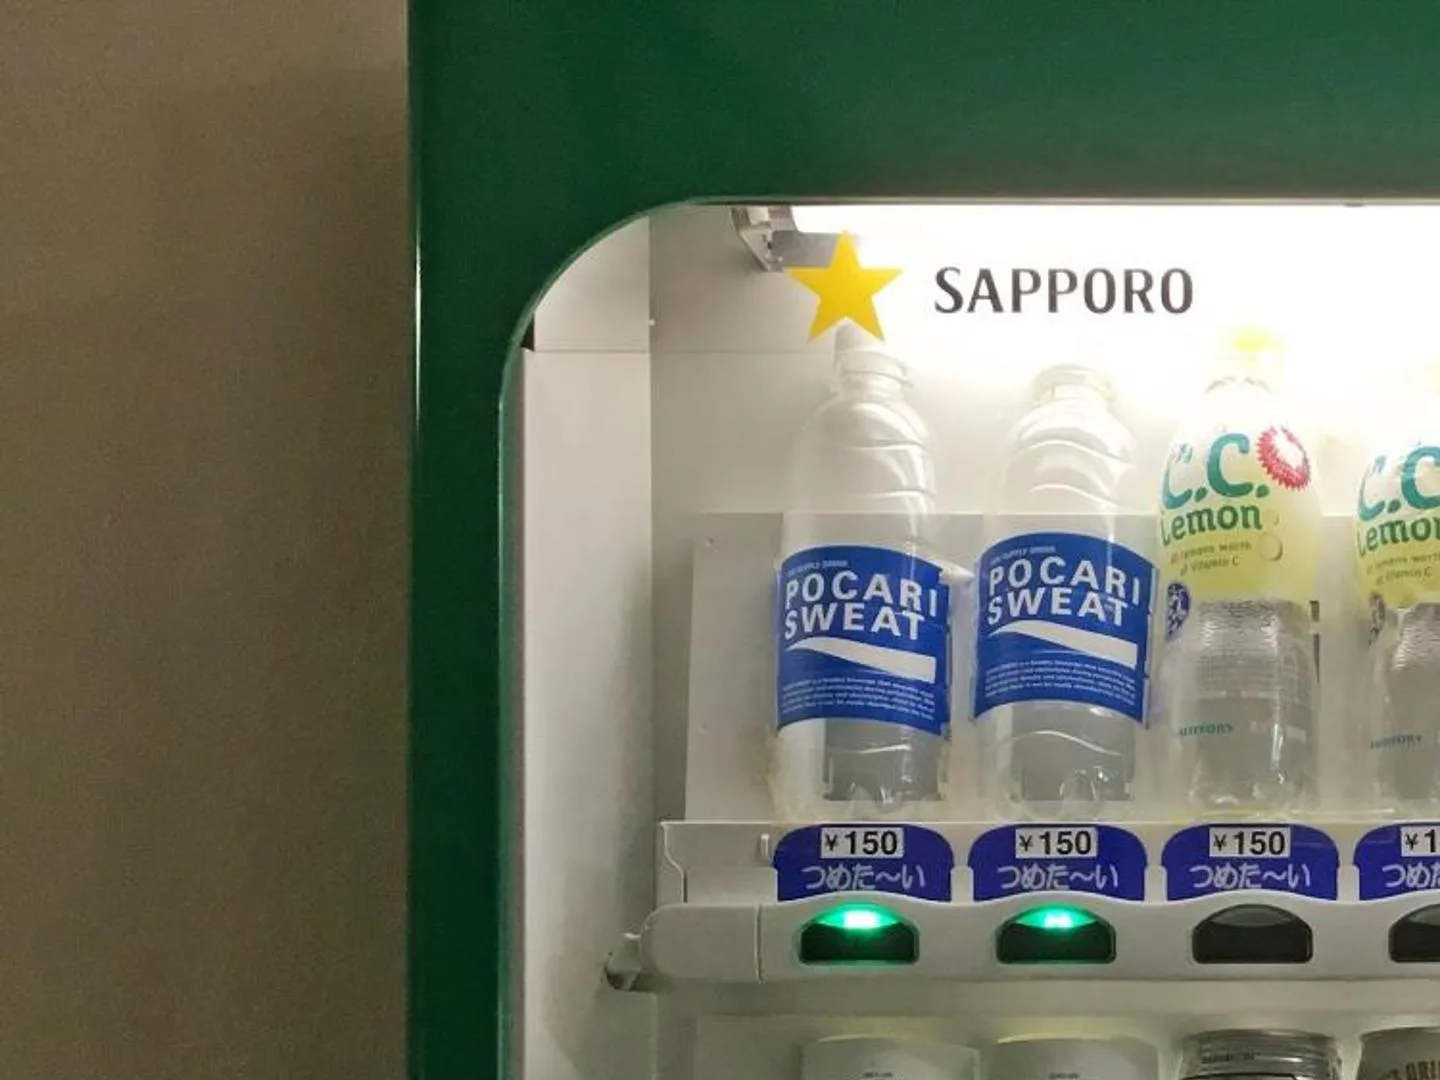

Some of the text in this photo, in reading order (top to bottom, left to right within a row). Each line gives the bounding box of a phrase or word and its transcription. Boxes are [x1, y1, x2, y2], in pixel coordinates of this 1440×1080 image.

[933, 266, 1194, 314] SAPPORO
[785, 569, 938, 618] POCARI
[988, 555, 1140, 606] POCARI
[784, 602, 925, 640] SWEAT
[987, 586, 1129, 628] SWEAT
[825, 831, 898, 855] ¥150
[1019, 831, 1092, 855] ¥150
[1214, 831, 1286, 855] ¥150
